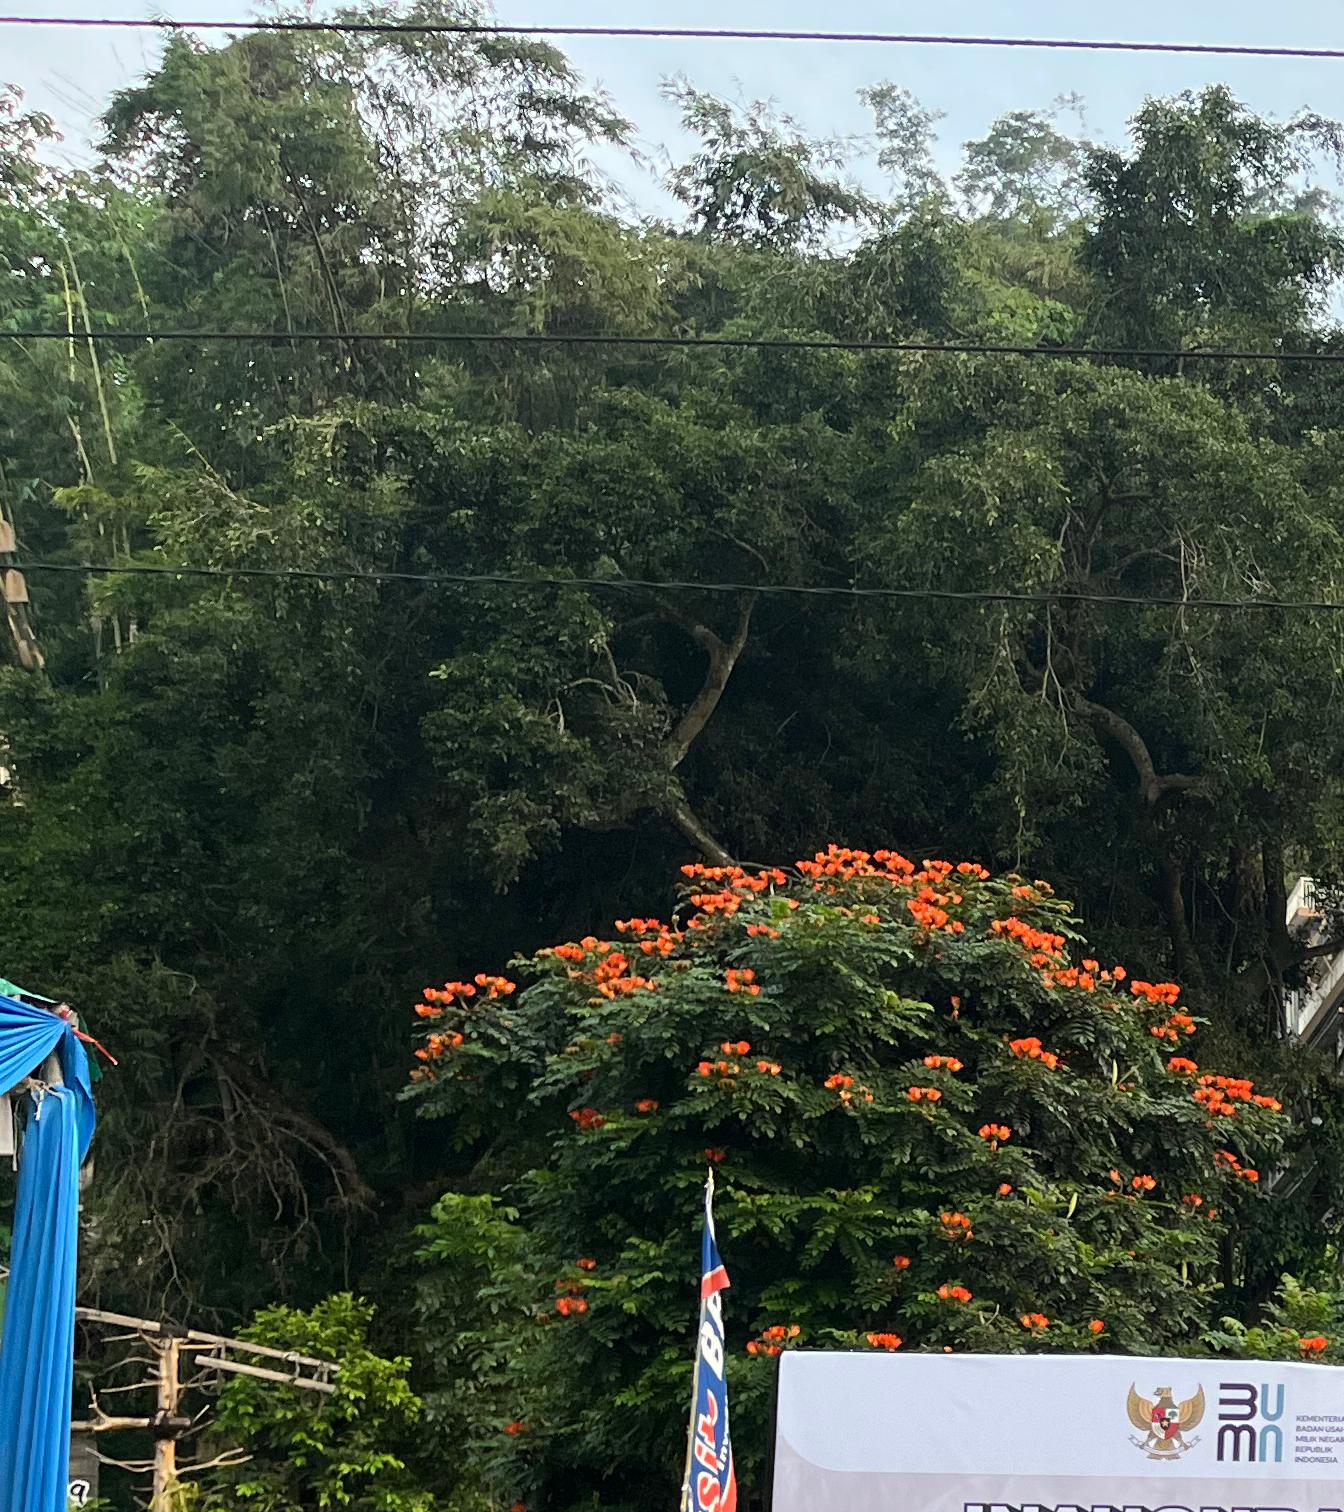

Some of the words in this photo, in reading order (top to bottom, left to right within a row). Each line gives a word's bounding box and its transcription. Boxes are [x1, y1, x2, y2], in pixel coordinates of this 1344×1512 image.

[1295, 1425, 1323, 1433] BADAN
[1295, 1446, 1333, 1454] REPUBLIK
[1294, 1456, 1338, 1464] INDONESIA
